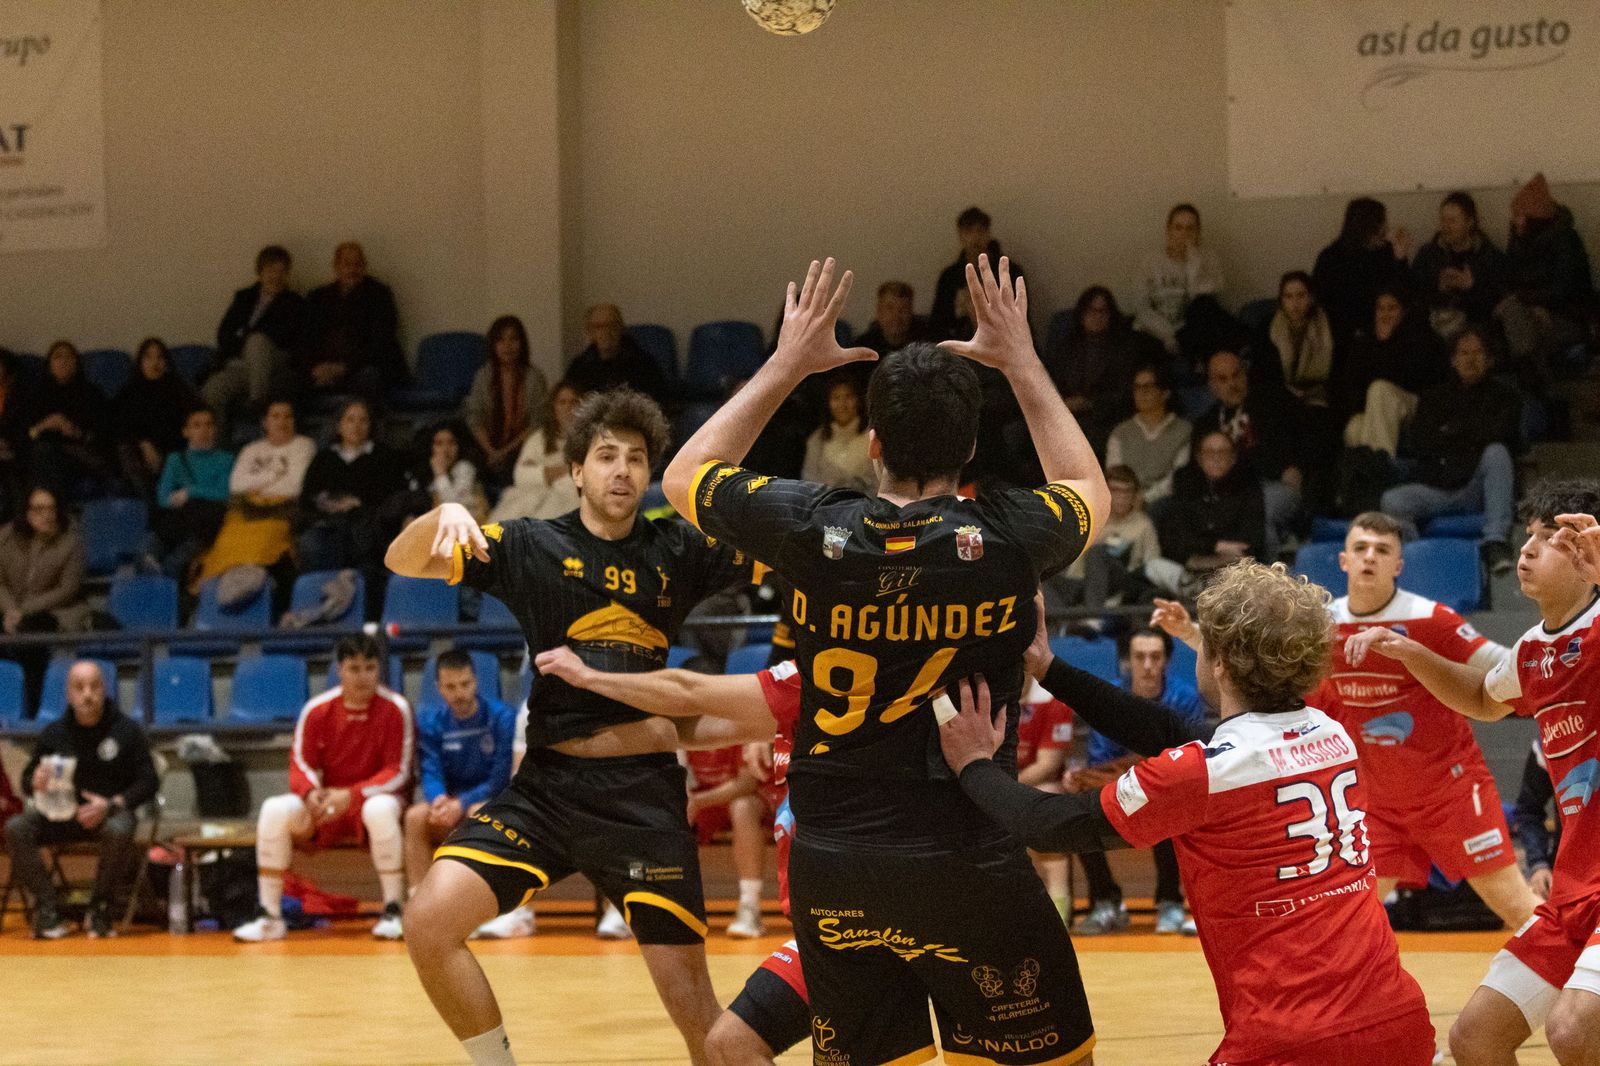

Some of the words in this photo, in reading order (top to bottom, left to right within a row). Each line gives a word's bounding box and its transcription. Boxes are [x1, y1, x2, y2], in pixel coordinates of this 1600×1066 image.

[1416, 20, 1461, 55] da
[1470, 17, 1571, 60] gusto
[902, 515, 944, 529] SALAMANCA
[604, 566, 637, 594] 99
[879, 566, 922, 593] Gil
[829, 593, 1018, 642] AGÚNDEZ
[1268, 748, 1296, 773] M.
[1290, 733, 1350, 769] CASADO
[1275, 768, 1371, 880] 36
[810, 907, 865, 918] AUTOCARES
